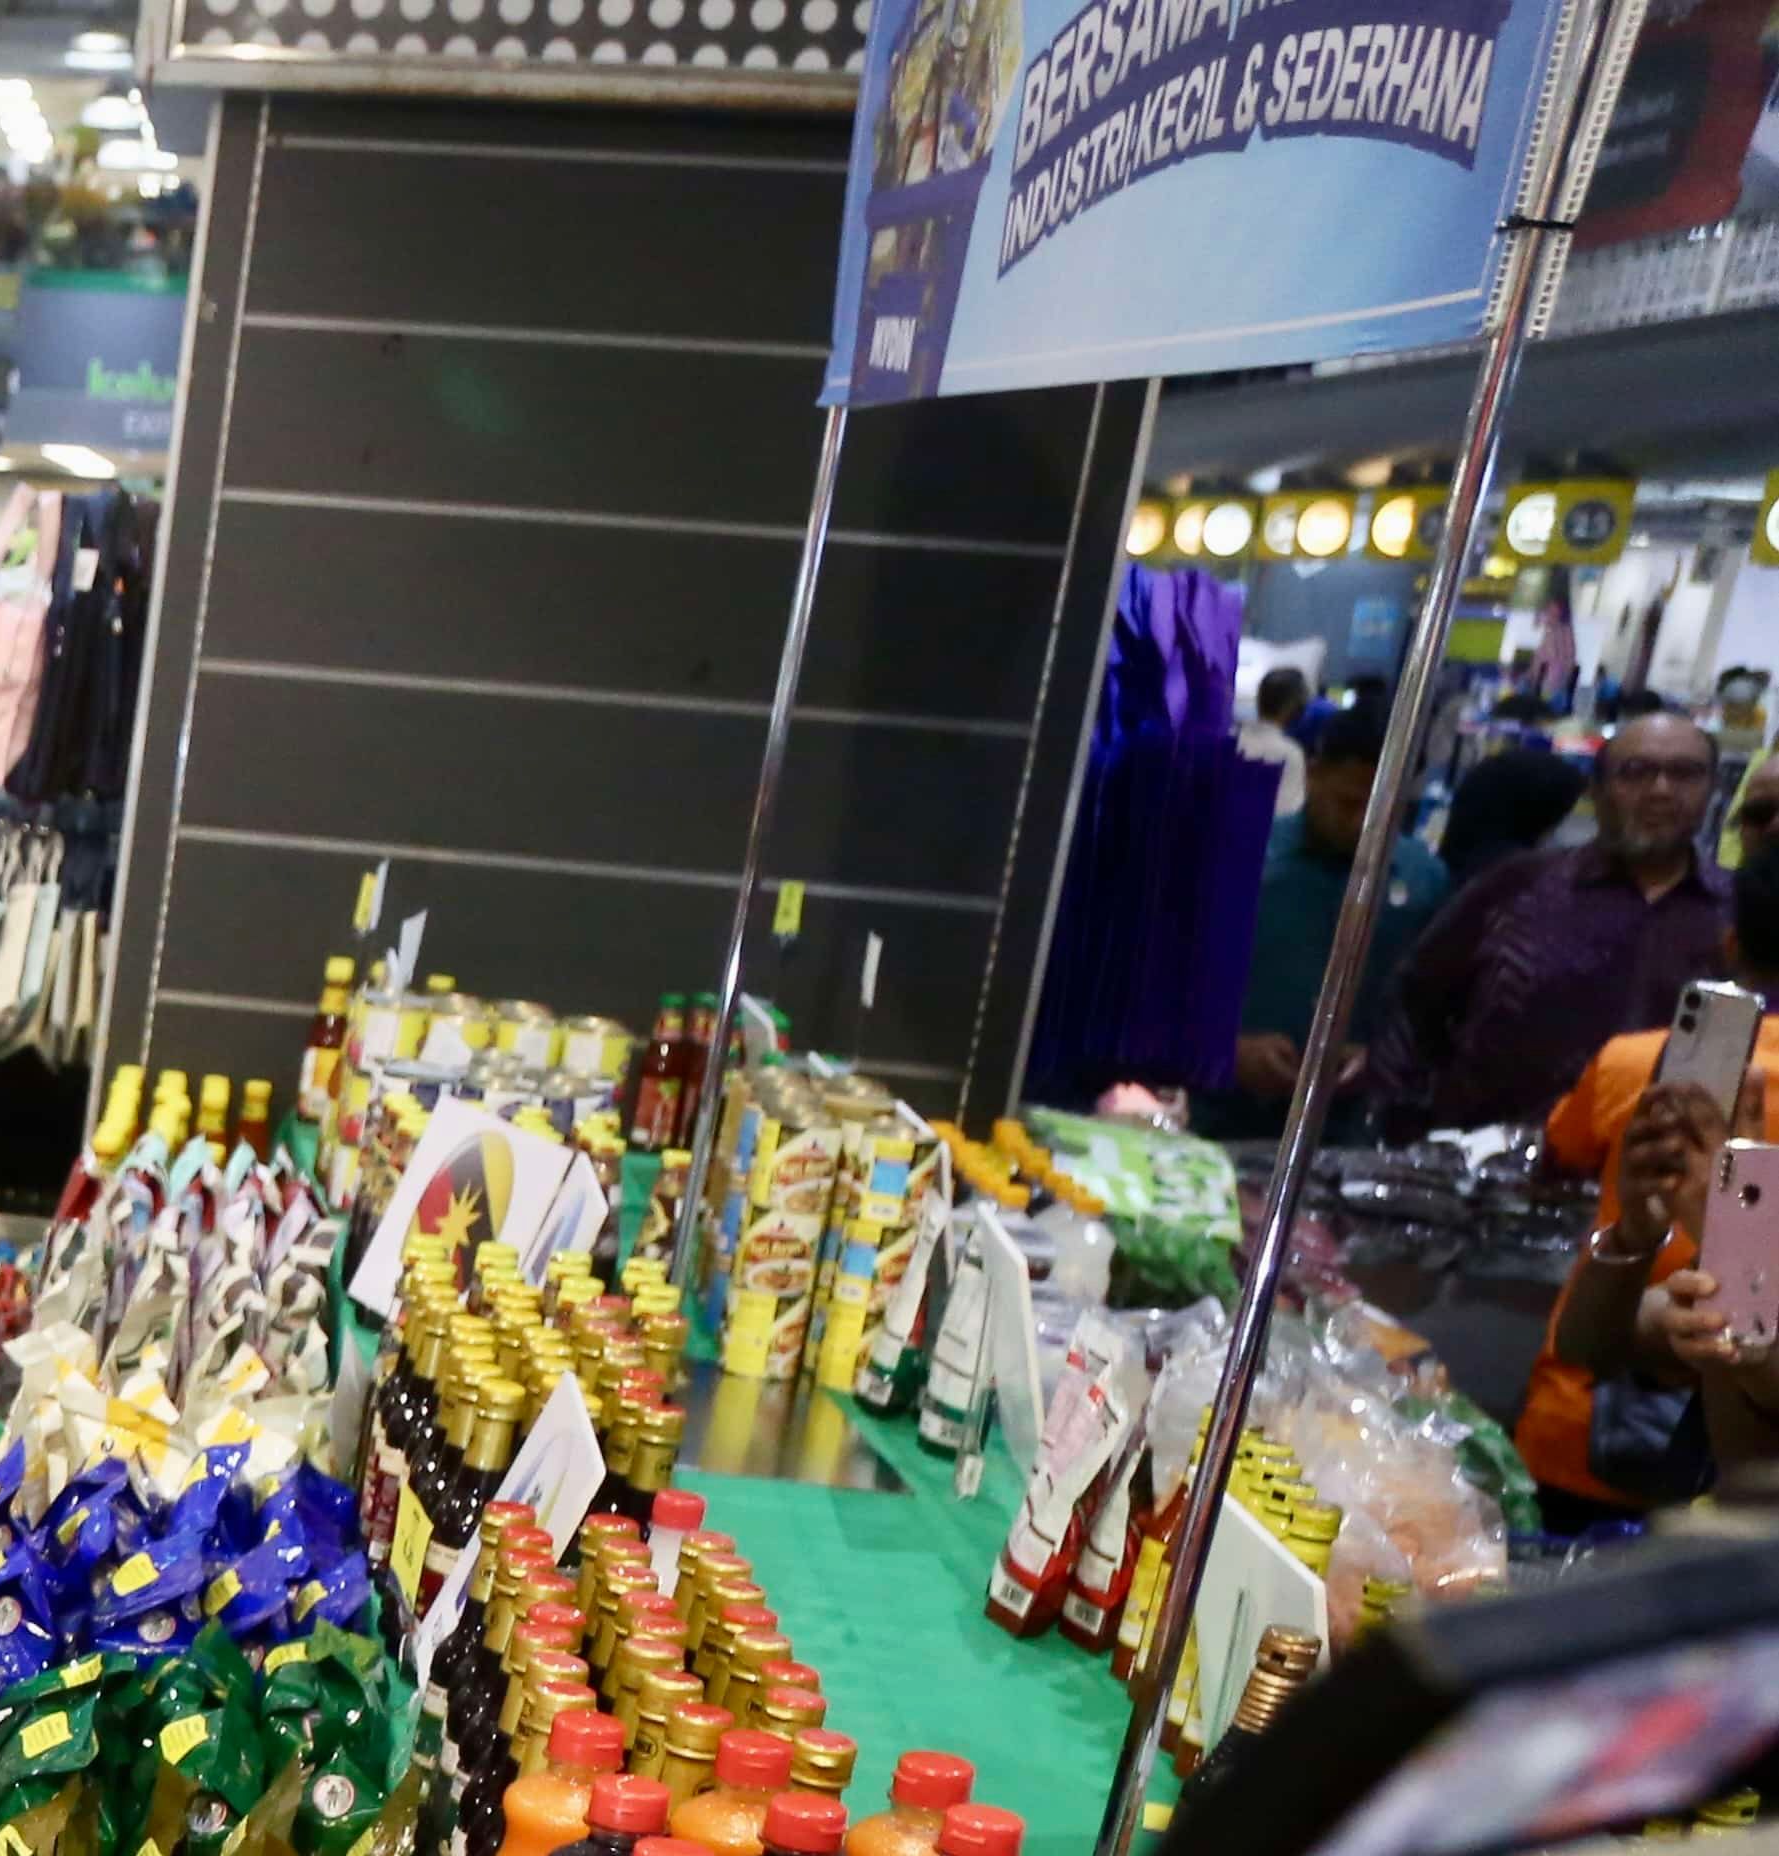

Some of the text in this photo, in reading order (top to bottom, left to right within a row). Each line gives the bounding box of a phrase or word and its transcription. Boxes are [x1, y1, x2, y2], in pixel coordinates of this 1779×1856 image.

[1002, 104, 1134, 266] INDUSTRI
[1132, 56, 1229, 171] KECIL
[1232, 42, 1264, 131] &
[1266, 23, 1495, 150] SEDERHANA
